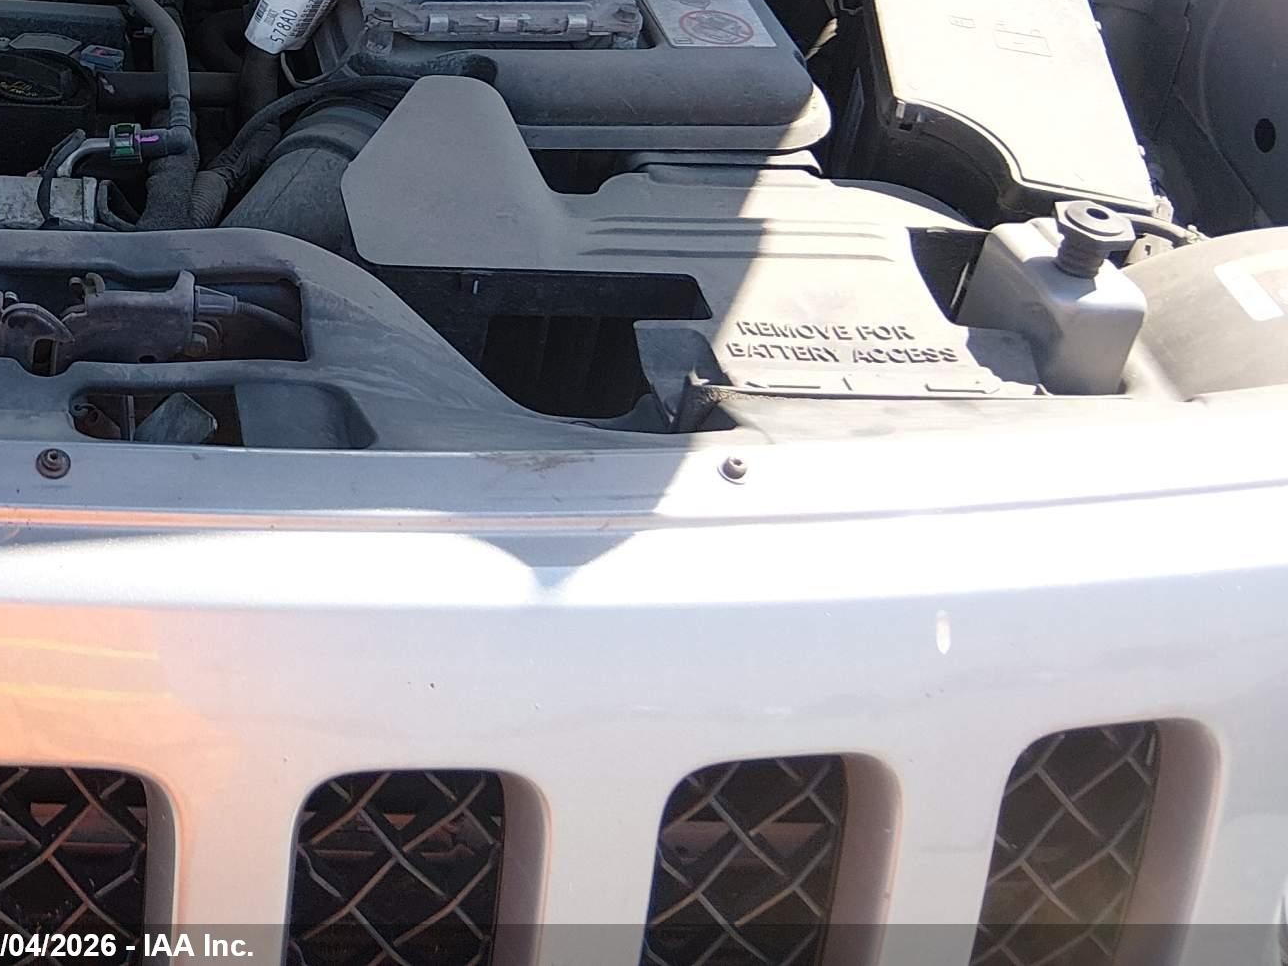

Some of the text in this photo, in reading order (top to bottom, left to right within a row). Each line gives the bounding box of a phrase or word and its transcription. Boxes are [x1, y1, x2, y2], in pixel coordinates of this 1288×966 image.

[736, 321, 915, 340] REMOVE FOR
[726, 342, 959, 363] BATTERY ACCESS
